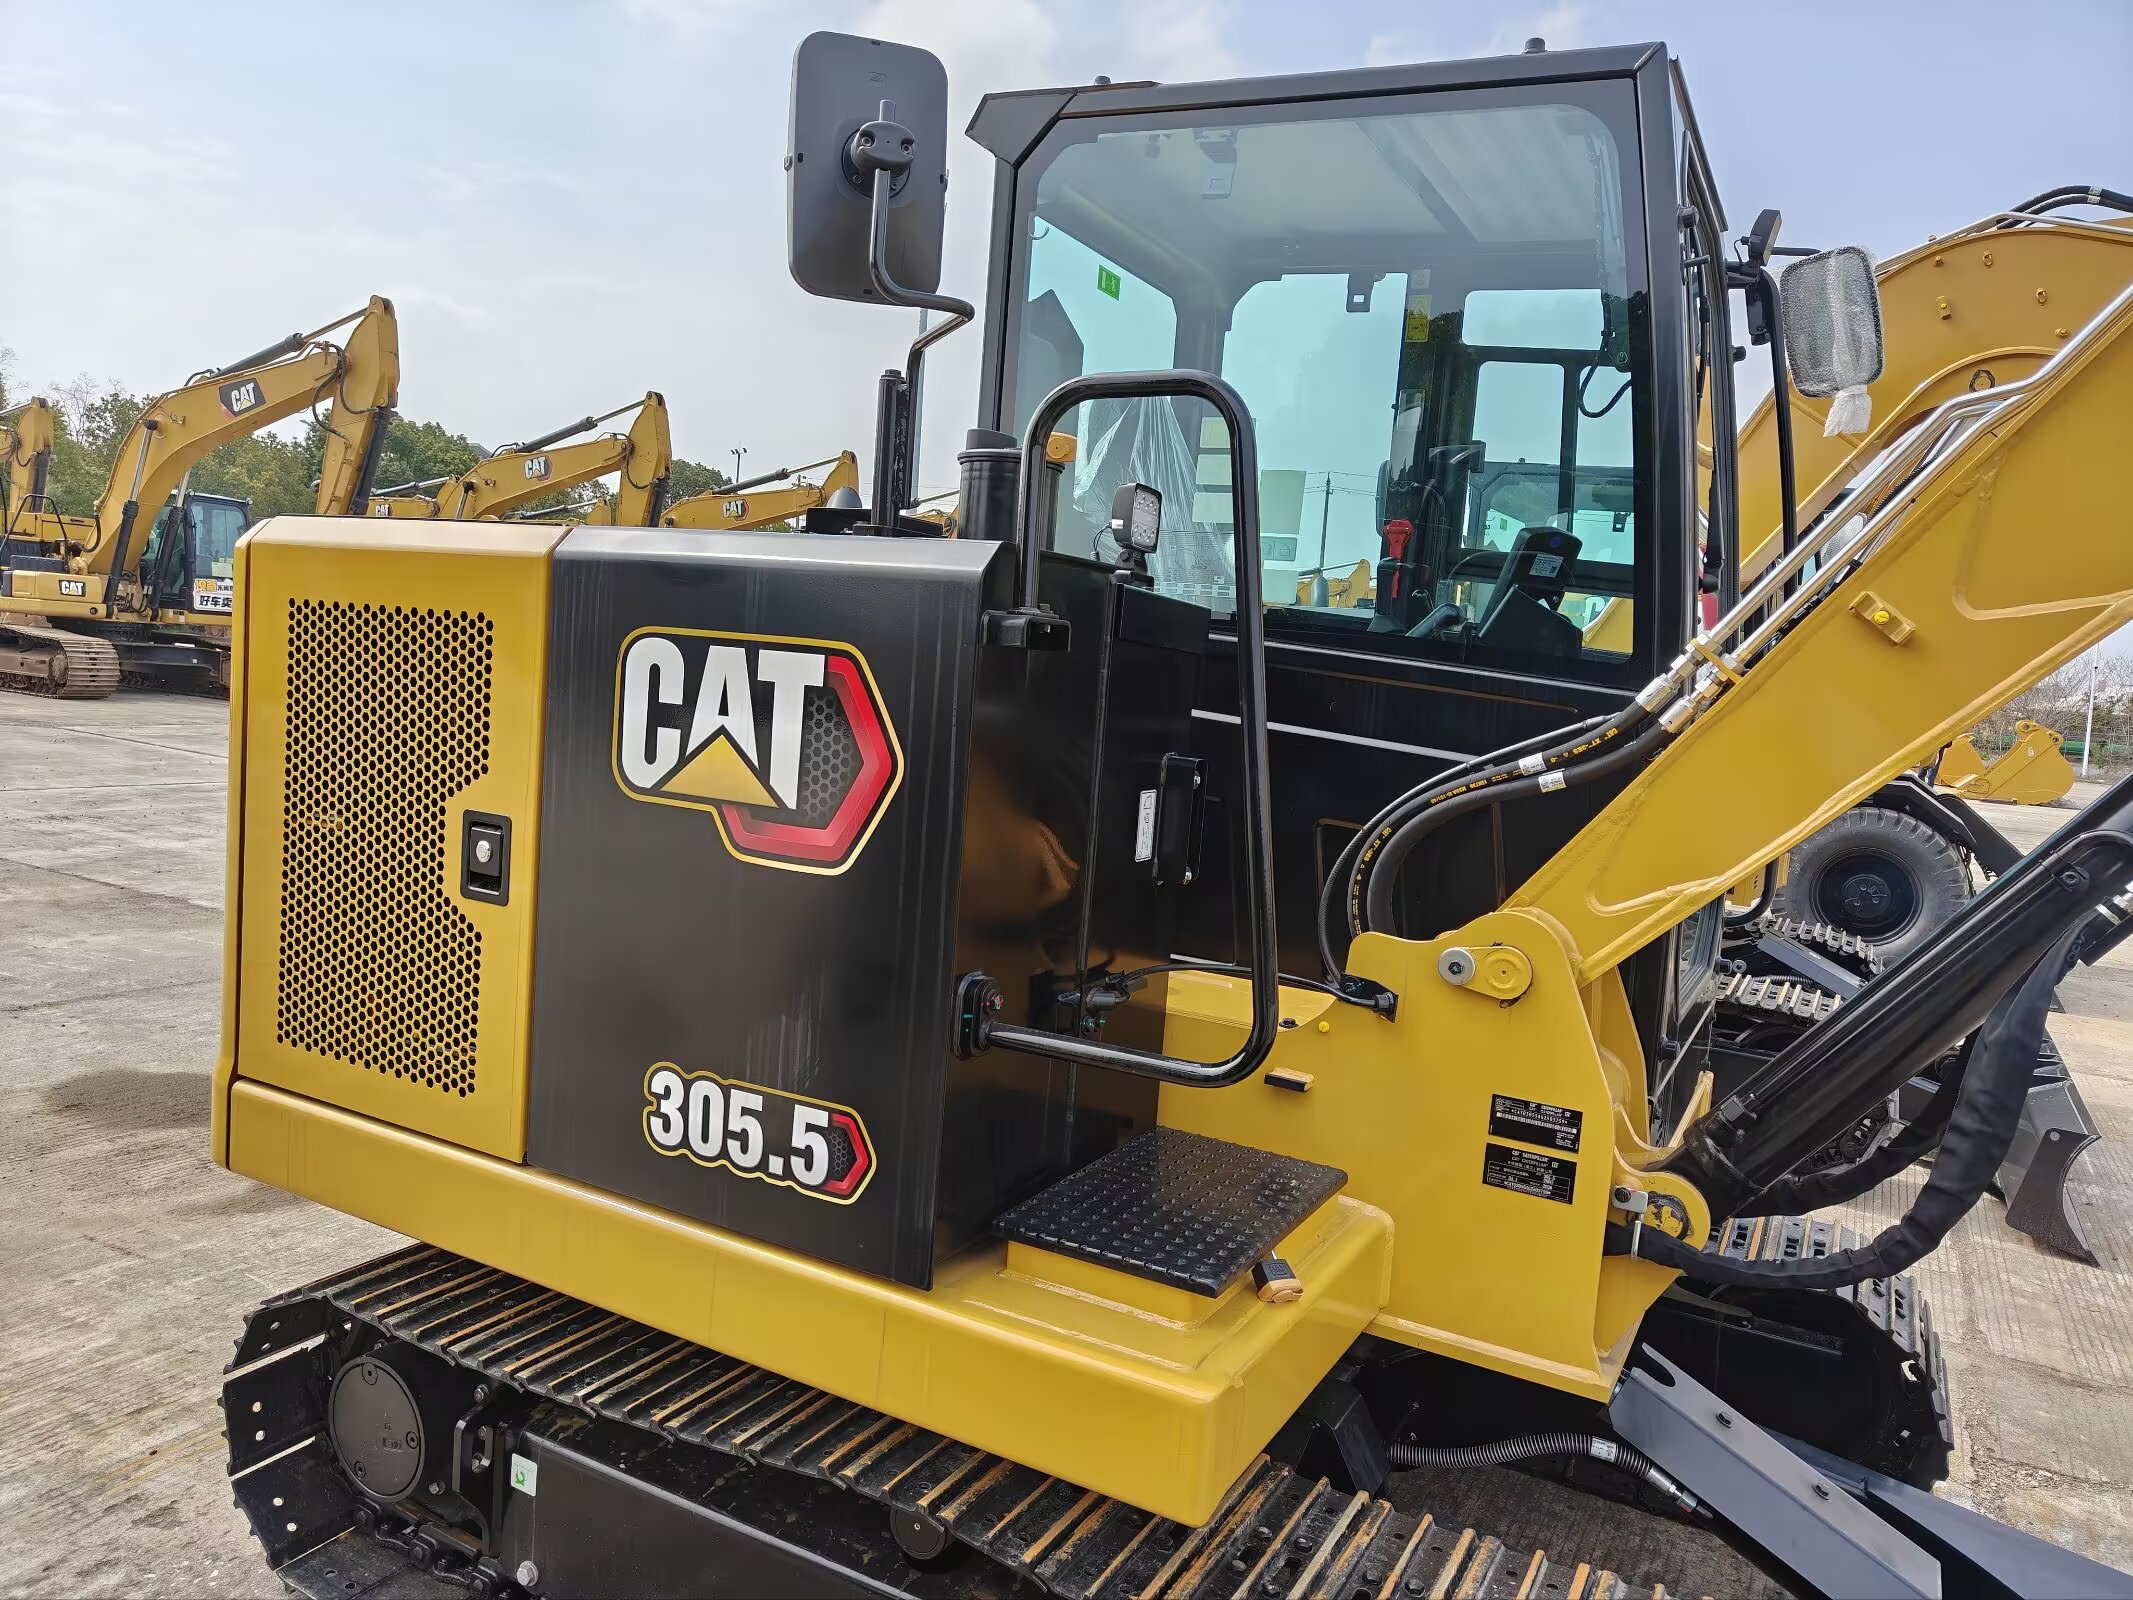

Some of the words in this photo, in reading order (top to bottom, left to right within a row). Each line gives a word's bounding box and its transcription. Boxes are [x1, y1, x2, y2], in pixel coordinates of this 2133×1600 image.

[231, 382, 256, 412] CAT
[524, 456, 547, 479] CAT
[722, 499, 744, 518] CAT
[61, 580, 84, 596] CAT
[621, 636, 828, 810] CAT
[649, 1070, 830, 1188] 305.5
